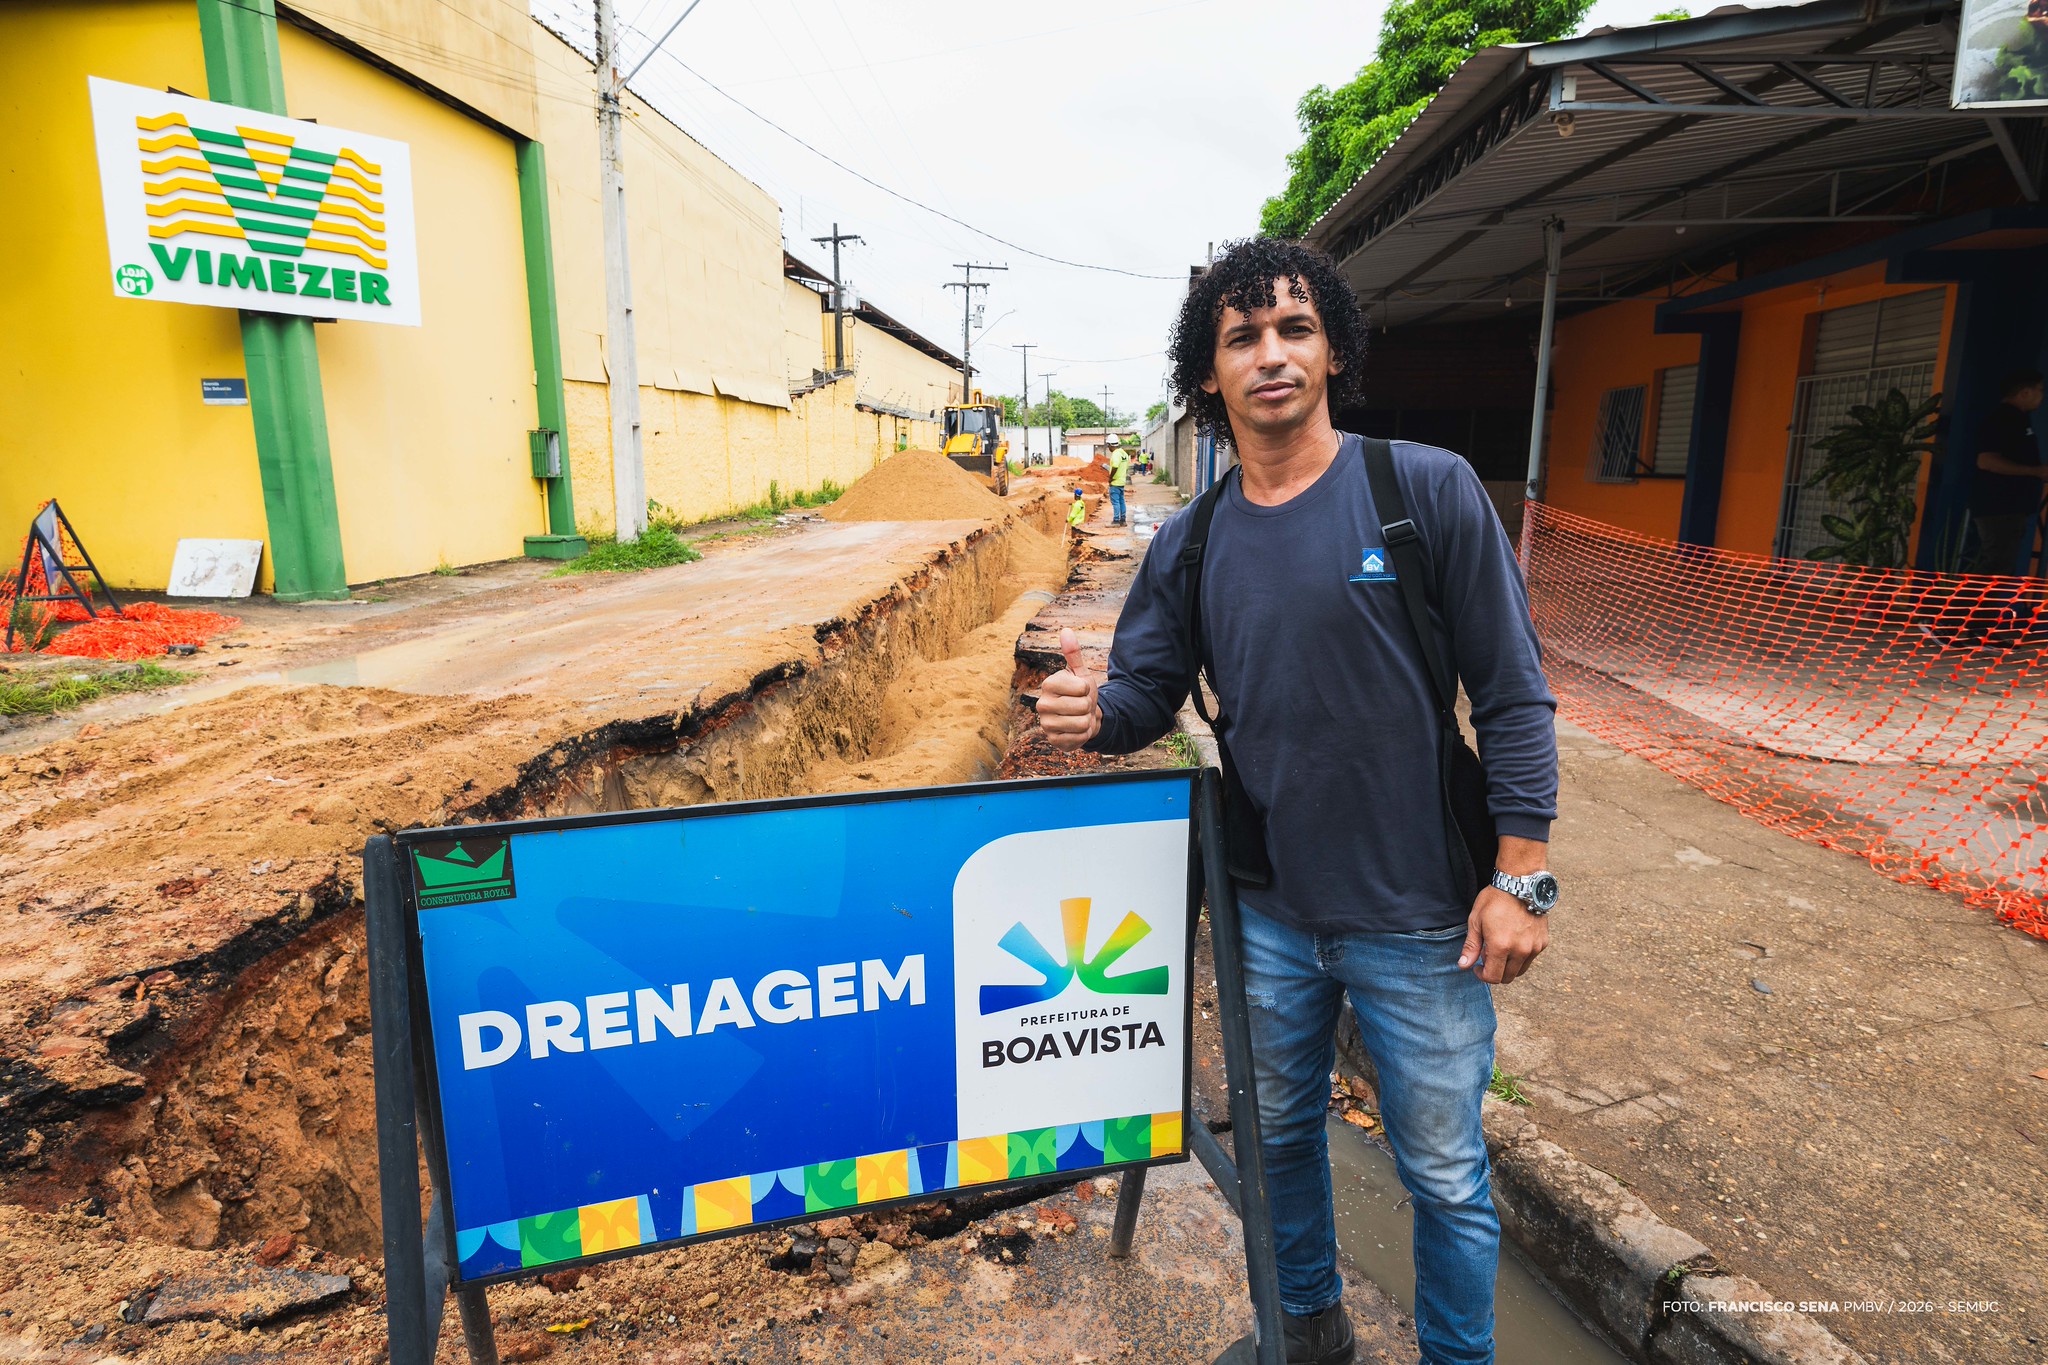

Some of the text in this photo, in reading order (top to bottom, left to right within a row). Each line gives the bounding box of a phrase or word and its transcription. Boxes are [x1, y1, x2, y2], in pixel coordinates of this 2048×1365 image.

[121, 266, 148, 279] LOJA
[148, 243, 392, 306] VIMEZER
[121, 277, 148, 294] 01
[420, 888, 511, 907] CONSTRUTORA ROYAL
[458, 953, 927, 1071] DRENAGEM
[1020, 1005, 1130, 1027] PREFEITURA DE
[982, 1021, 1166, 1068] BOA VISTA
